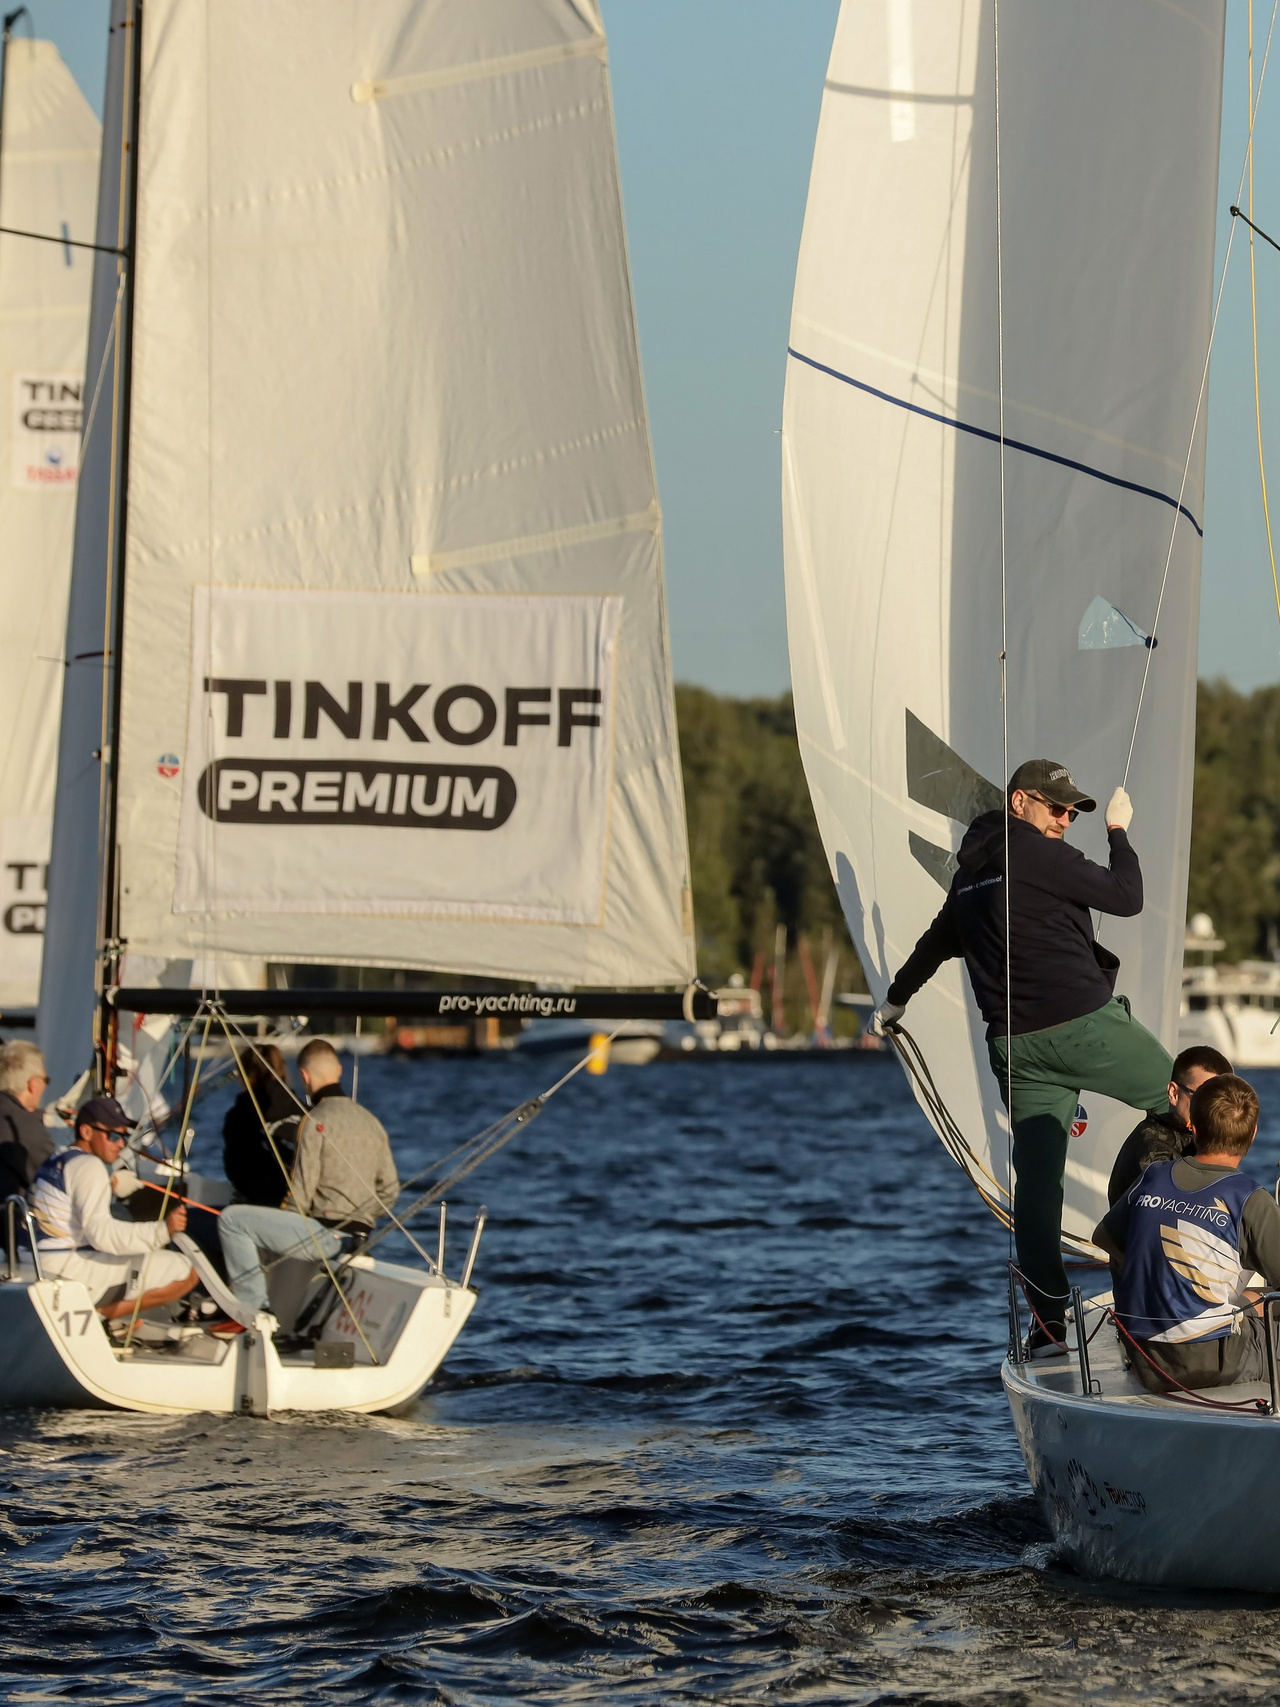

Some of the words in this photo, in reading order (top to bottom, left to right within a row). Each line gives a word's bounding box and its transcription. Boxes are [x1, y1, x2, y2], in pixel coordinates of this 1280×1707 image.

[204, 678, 601, 747] TINKOFF
[217, 769, 499, 819] PREMIUM
[439, 993, 577, 1016] pro-yachting.ru
[1135, 1194, 1229, 1227] PROYACHTING
[58, 1310, 93, 1337] 17
